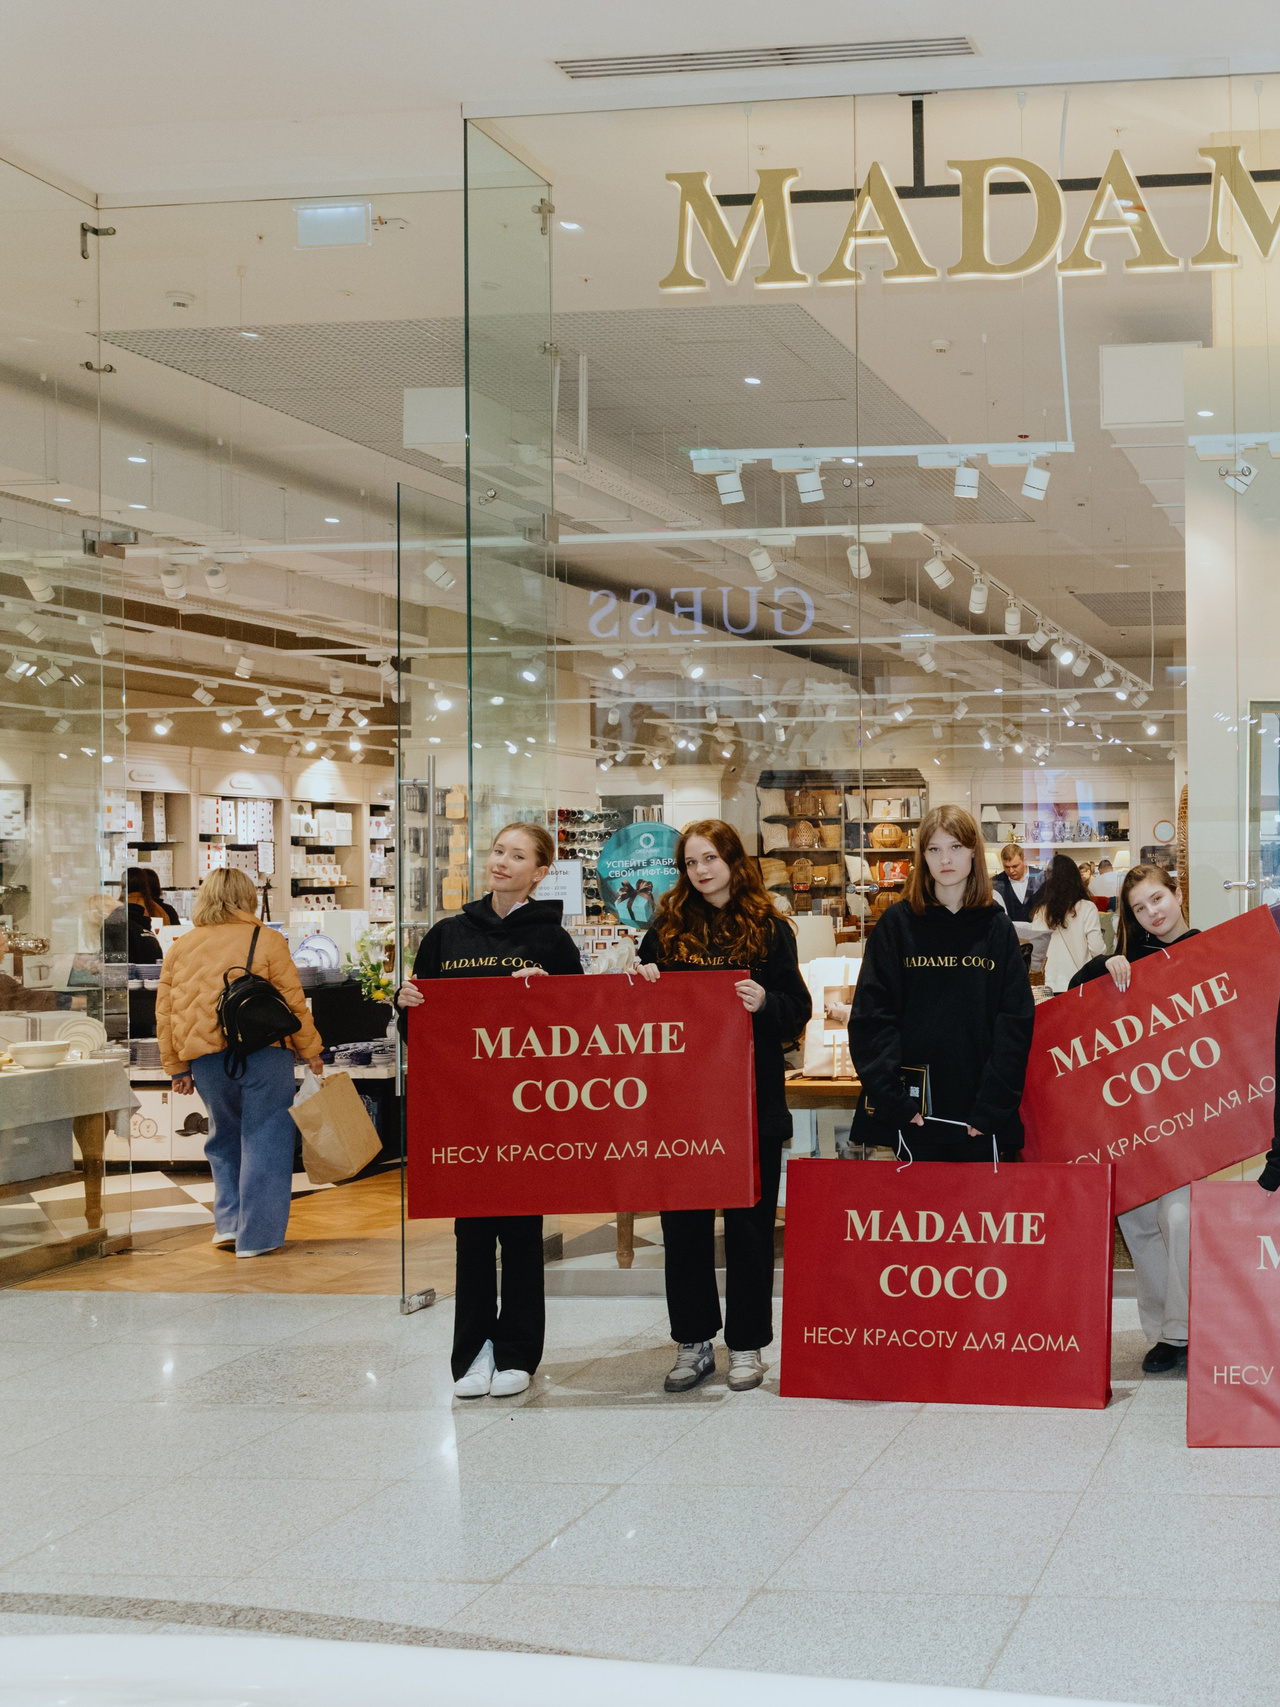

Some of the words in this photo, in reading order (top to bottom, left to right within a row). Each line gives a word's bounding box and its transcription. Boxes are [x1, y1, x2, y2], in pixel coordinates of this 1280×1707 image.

[606, 859, 648, 868] УСПЕЙТЕ
[649, 858, 678, 867] ЗАБРА
[608, 868, 635, 878] СВОЙ
[440, 957, 498, 972] MADAME
[961, 956, 996, 971] COCO
[1046, 972, 1239, 1078] MADAME
[473, 1022, 685, 1059] MADAME
[1102, 1036, 1221, 1107] COCO
[513, 1077, 647, 1112] COCO
[1107, 1108, 1194, 1160] КРАСОТУ
[1203, 1089, 1242, 1122] ДЛЯ
[1247, 1075, 1276, 1103] ДО
[433, 1146, 489, 1164] НЕСУ
[498, 1143, 597, 1161] КРАСОТУ
[604, 1141, 647, 1160] ДЛЯ
[655, 1139, 725, 1158] ДОМА
[844, 1210, 1045, 1244] MADAME
[880, 1265, 1007, 1299] COCO
[805, 1327, 856, 1345] НЕСУ
[864, 1329, 957, 1348] КРАСОТУ
[963, 1332, 1004, 1351] ДЛЯ
[1012, 1333, 1079, 1352] ДОМА
[1214, 1366, 1274, 1385] НЕСУ
